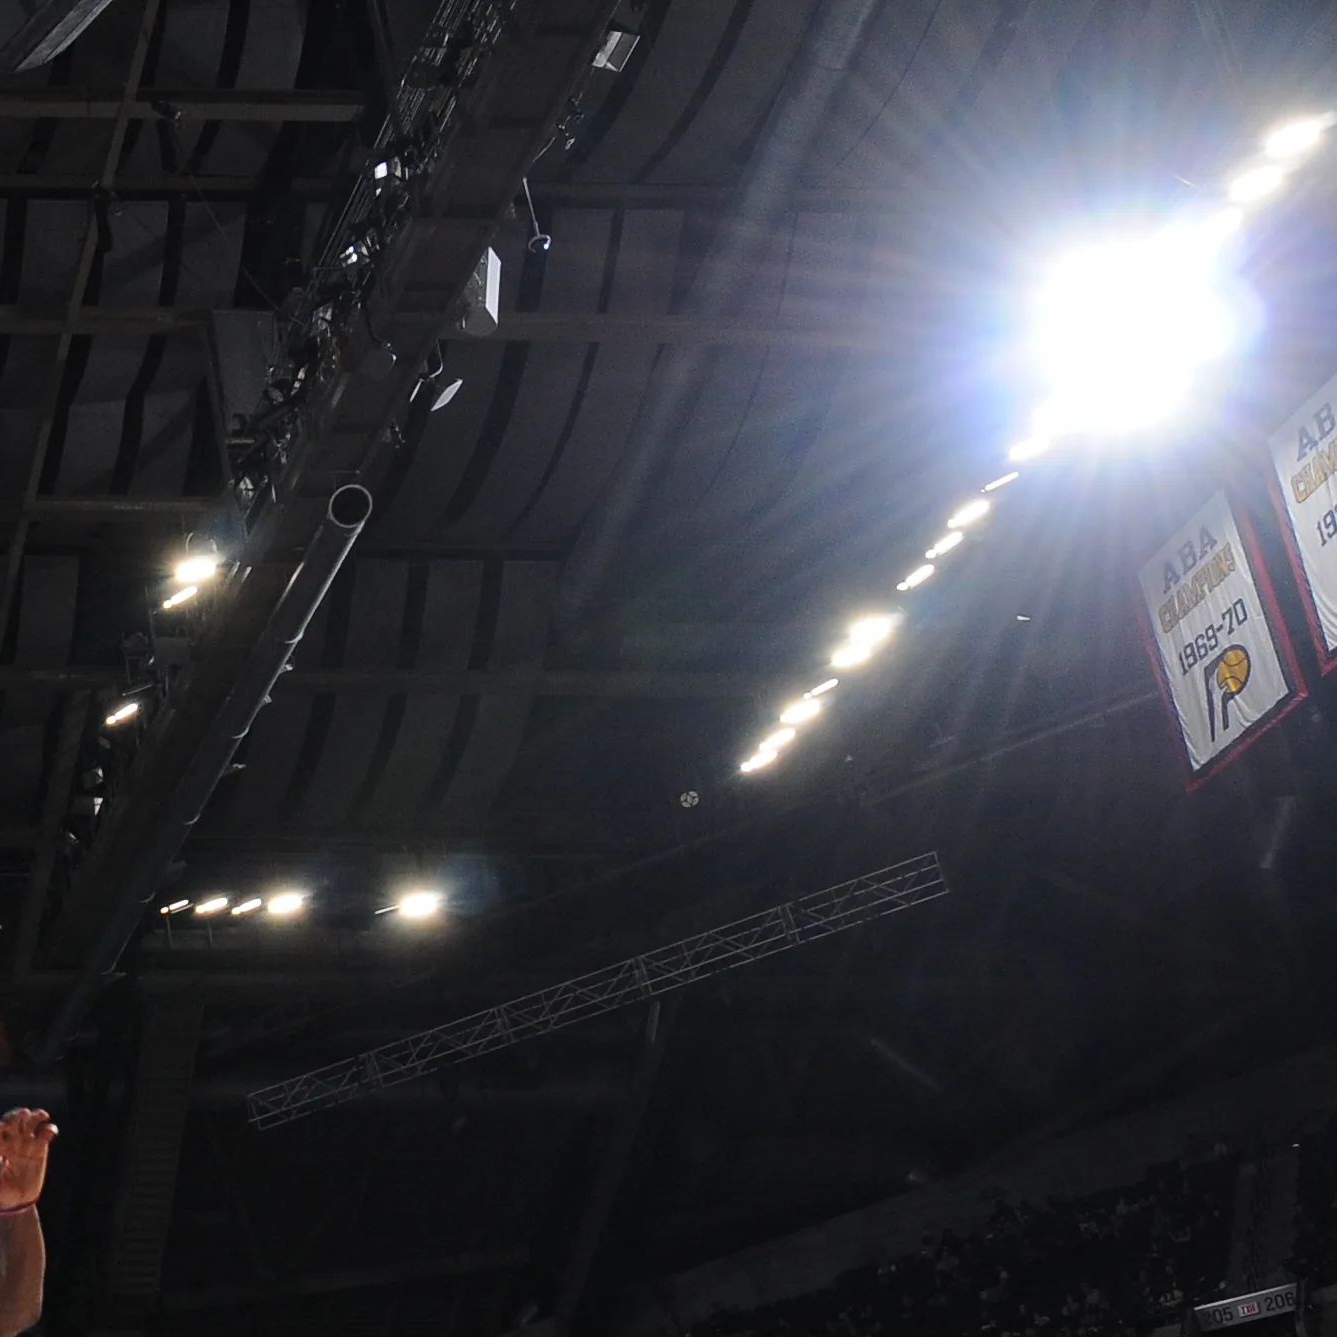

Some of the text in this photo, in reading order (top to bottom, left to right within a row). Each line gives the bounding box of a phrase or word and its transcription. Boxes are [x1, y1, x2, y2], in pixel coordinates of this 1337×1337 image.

[1162, 525, 1217, 595] ABA
[1178, 598, 1249, 676] 1969-70
[1202, 1307, 1234, 1325] 205
[1264, 1292, 1296, 1312] 206
